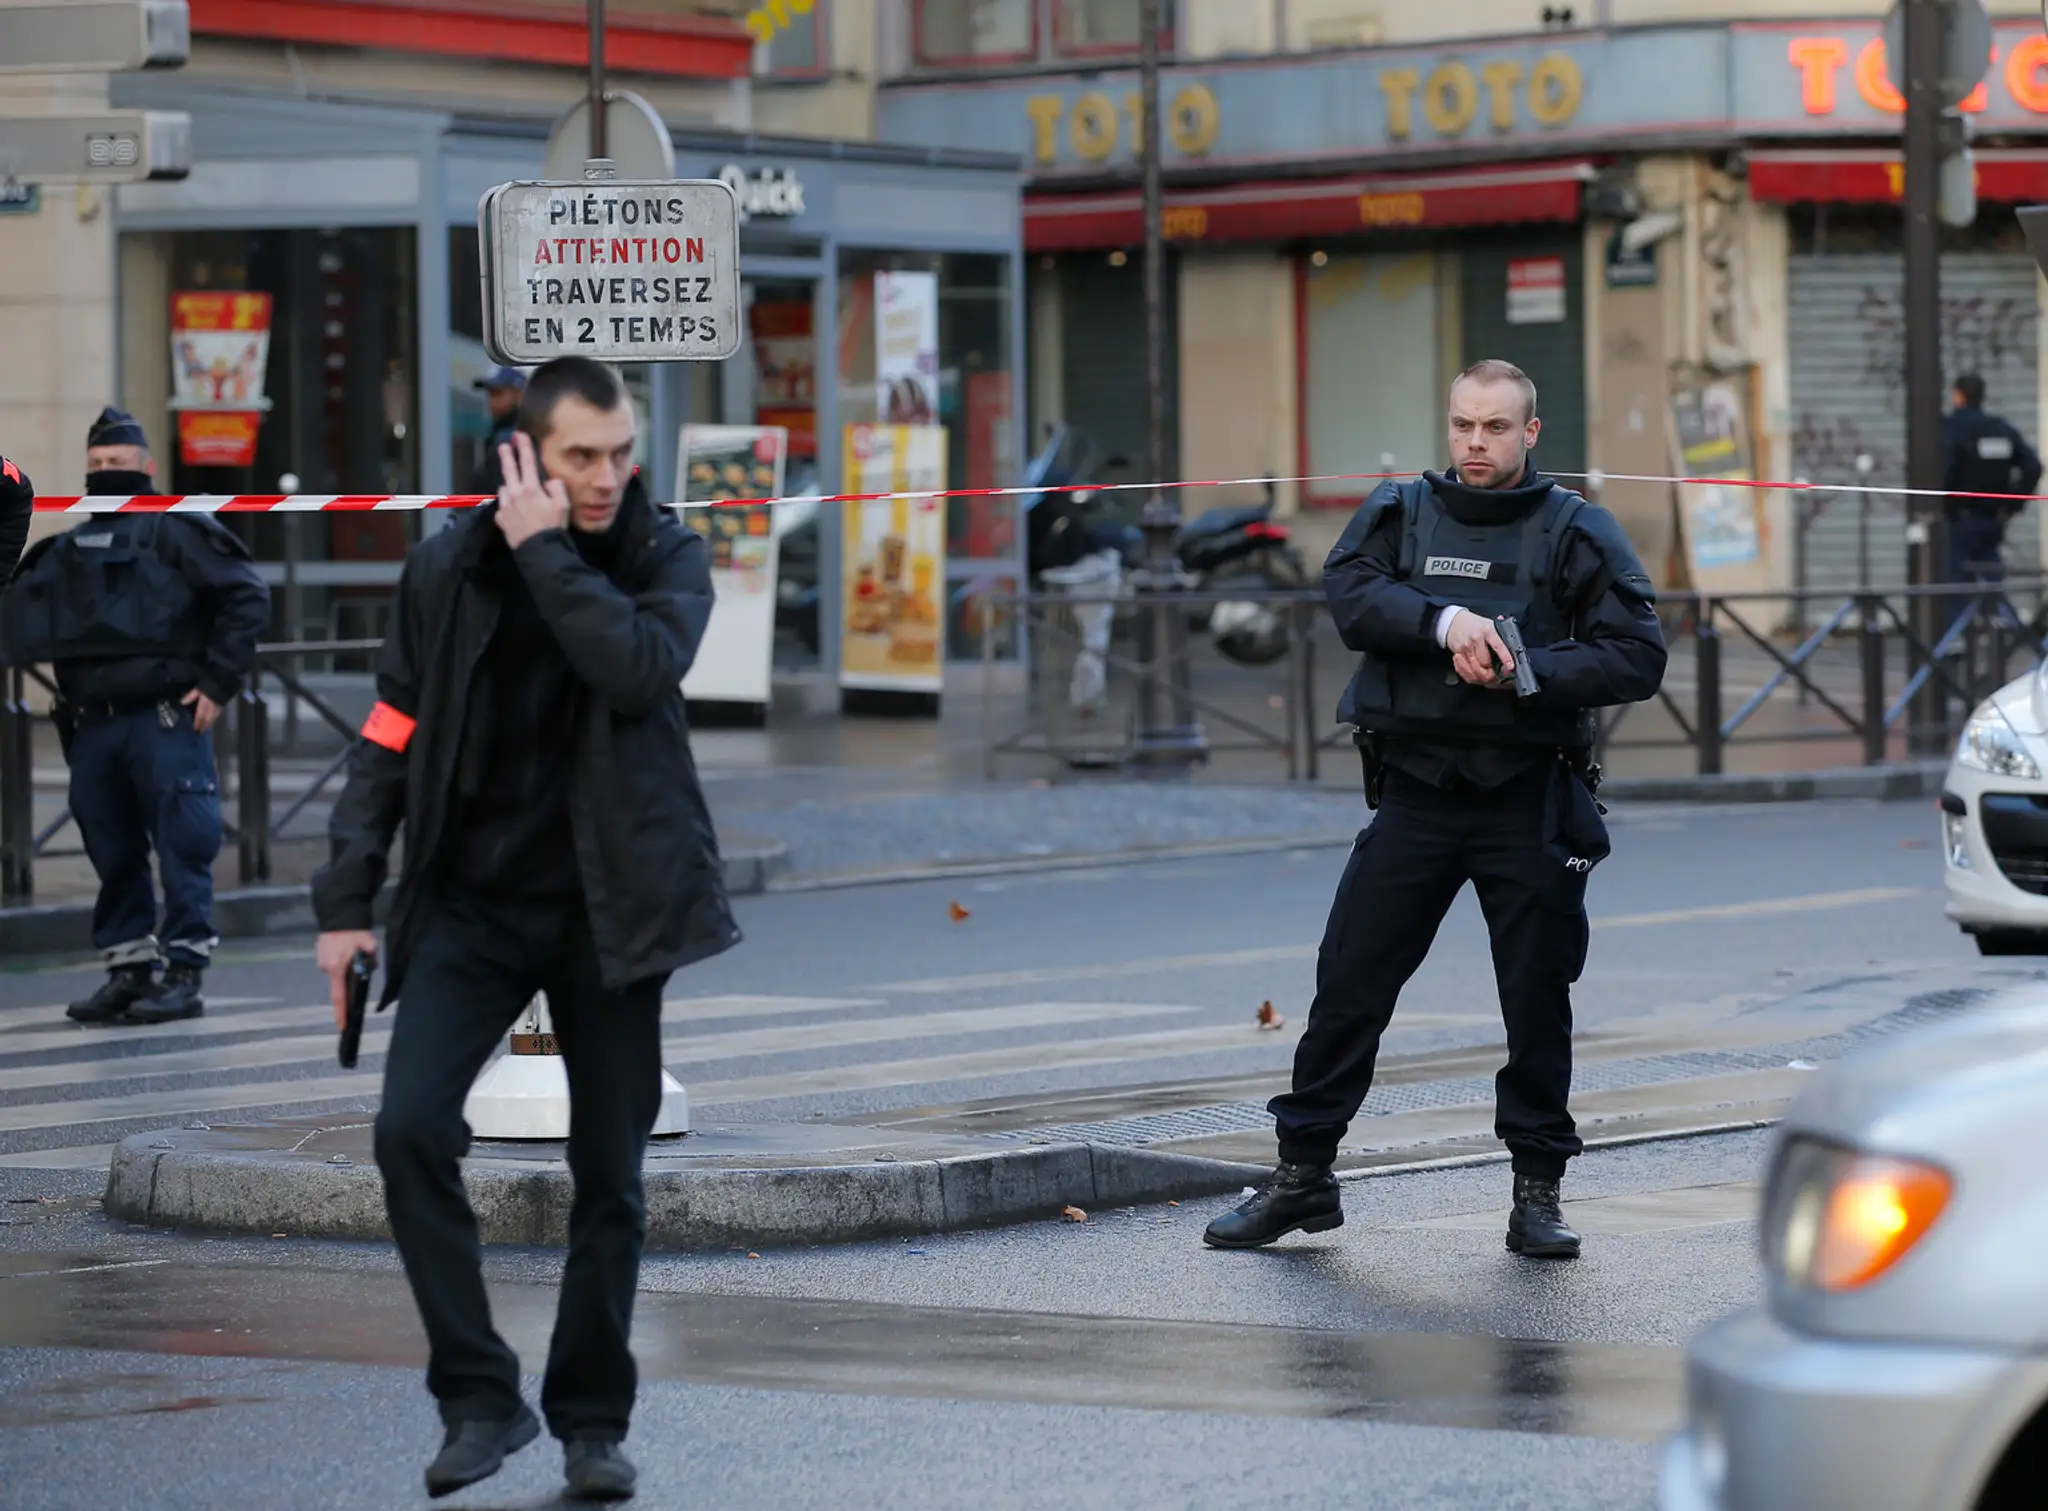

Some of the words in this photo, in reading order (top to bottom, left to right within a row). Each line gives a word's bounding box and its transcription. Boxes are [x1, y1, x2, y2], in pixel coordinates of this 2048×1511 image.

[1380, 52, 1582, 136] TOTO
[550, 193, 684, 225] PIÉTONS
[535, 236, 704, 264] ATTENTION
[527, 277, 713, 304] TRAVERSEZ
[525, 318, 564, 344] EN
[578, 317, 596, 343] 2
[610, 316, 718, 343] TEMPS
[1431, 560, 1483, 574] POLICE
